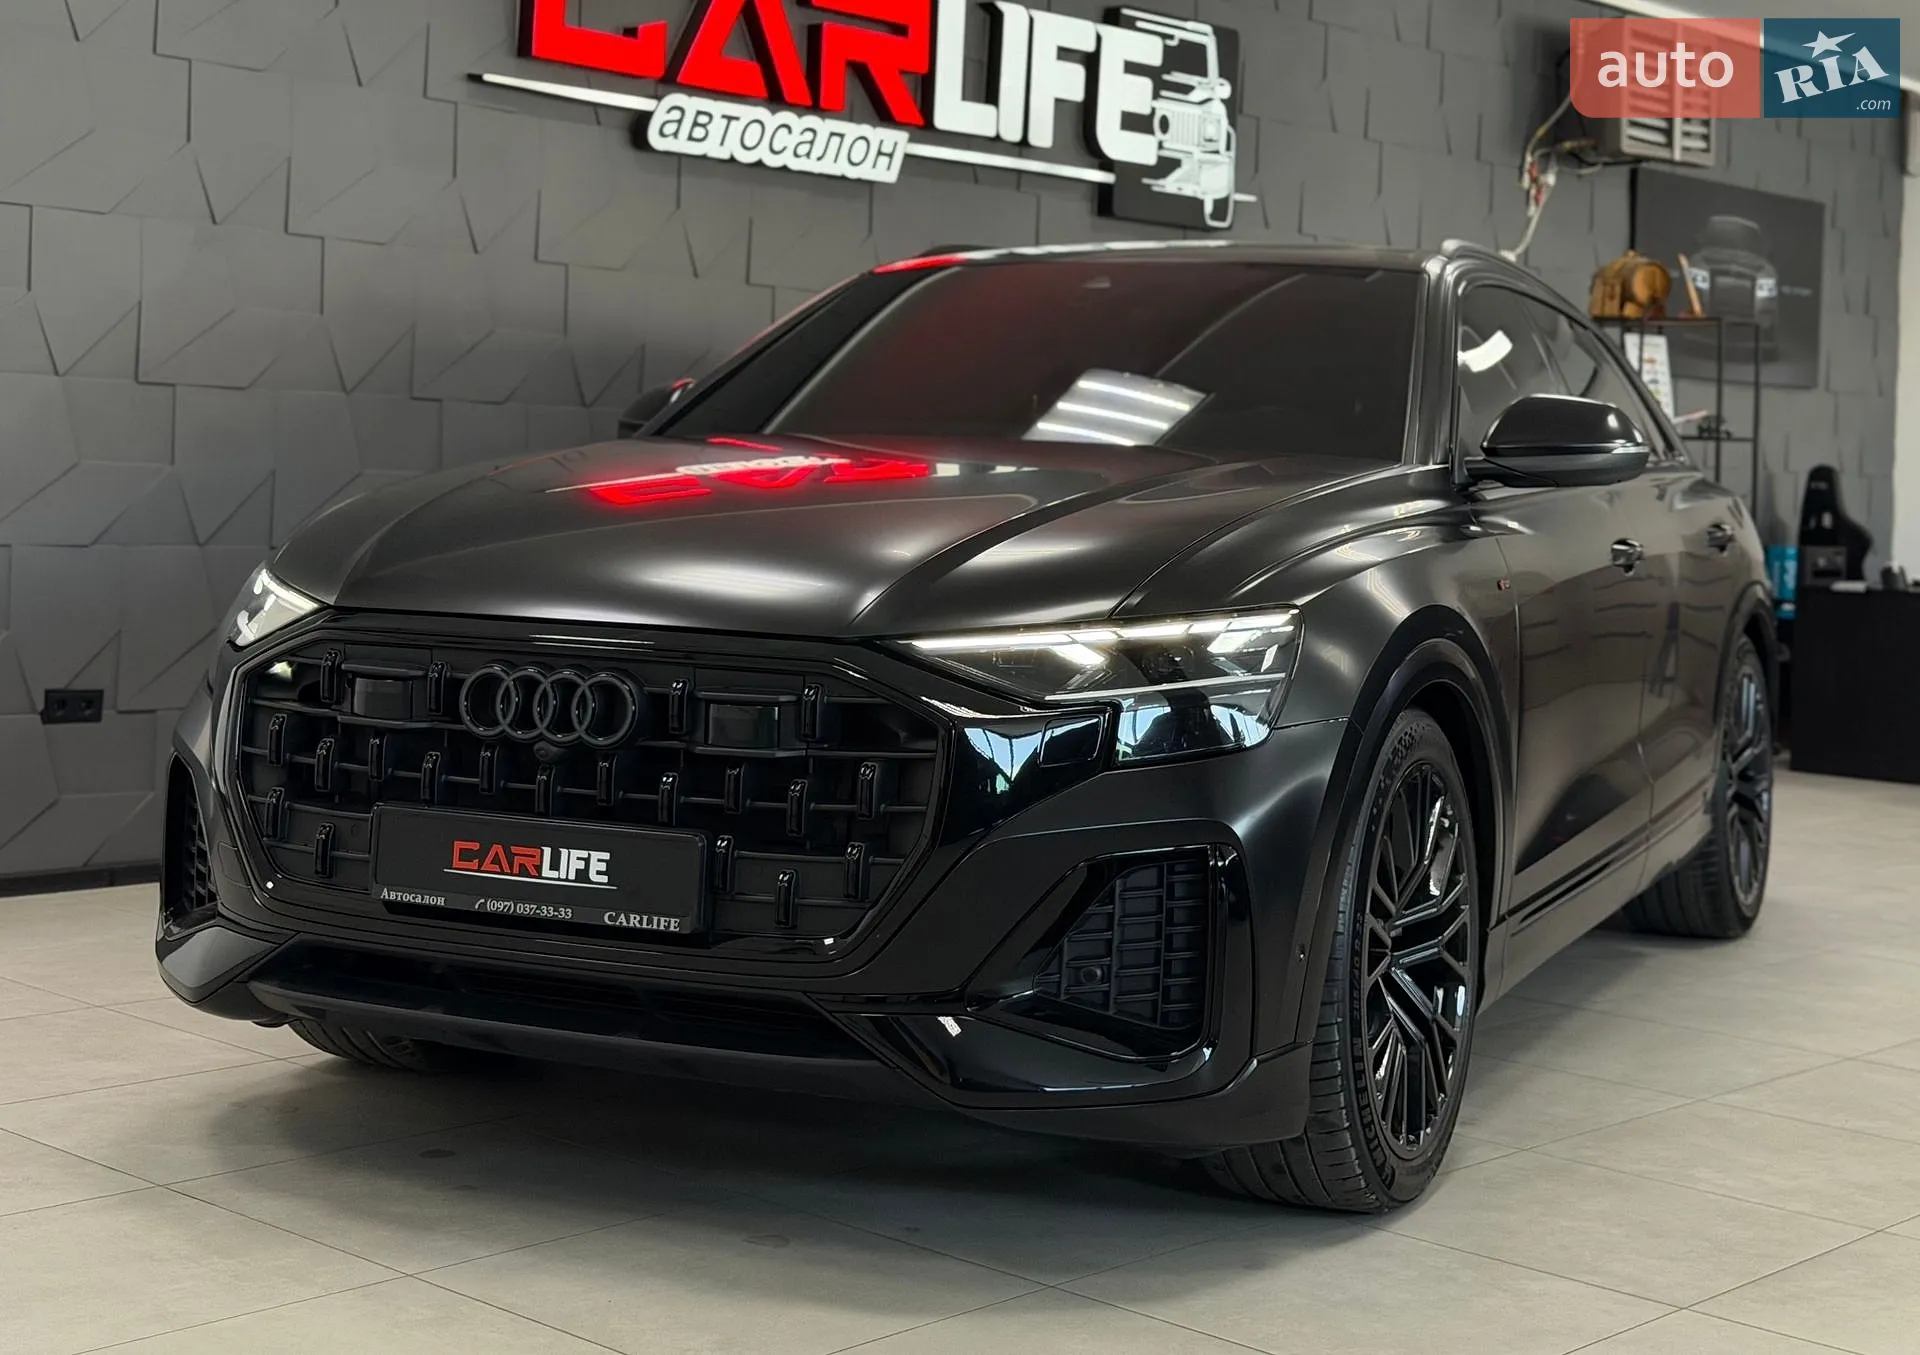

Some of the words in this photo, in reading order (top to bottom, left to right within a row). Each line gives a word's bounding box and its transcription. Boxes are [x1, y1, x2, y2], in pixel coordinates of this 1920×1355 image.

[658, 103, 900, 173] автосалон
[452, 840, 611, 884] CARLIFE
[380, 887, 446, 906] Автосалон
[486, 897, 514, 915] (097)
[516, 901, 573, 920] 037-33-33
[603, 911, 681, 932] CARLIFE
[1352, 1036, 1387, 1167] MICHELIN
